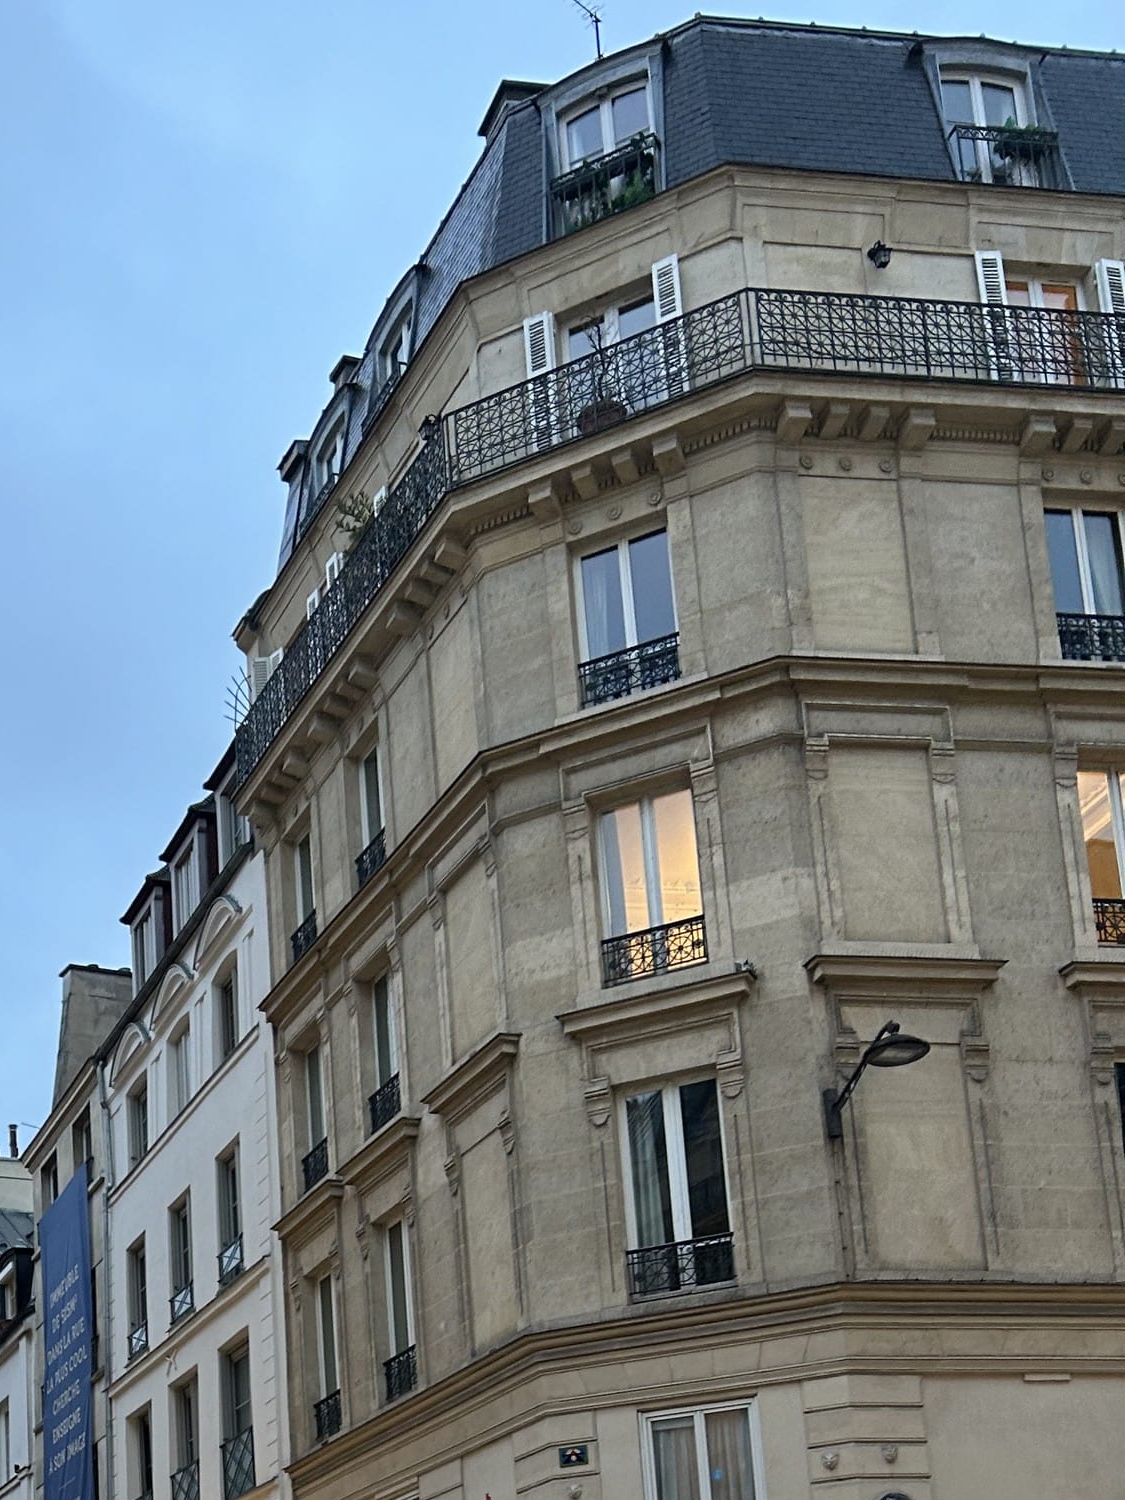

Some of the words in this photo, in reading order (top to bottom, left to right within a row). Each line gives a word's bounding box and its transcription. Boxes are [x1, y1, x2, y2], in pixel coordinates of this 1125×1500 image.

[47, 1338, 63, 1366] DANS
[71, 1316, 85, 1340] RUE
[69, 1344, 88, 1372] COOL
